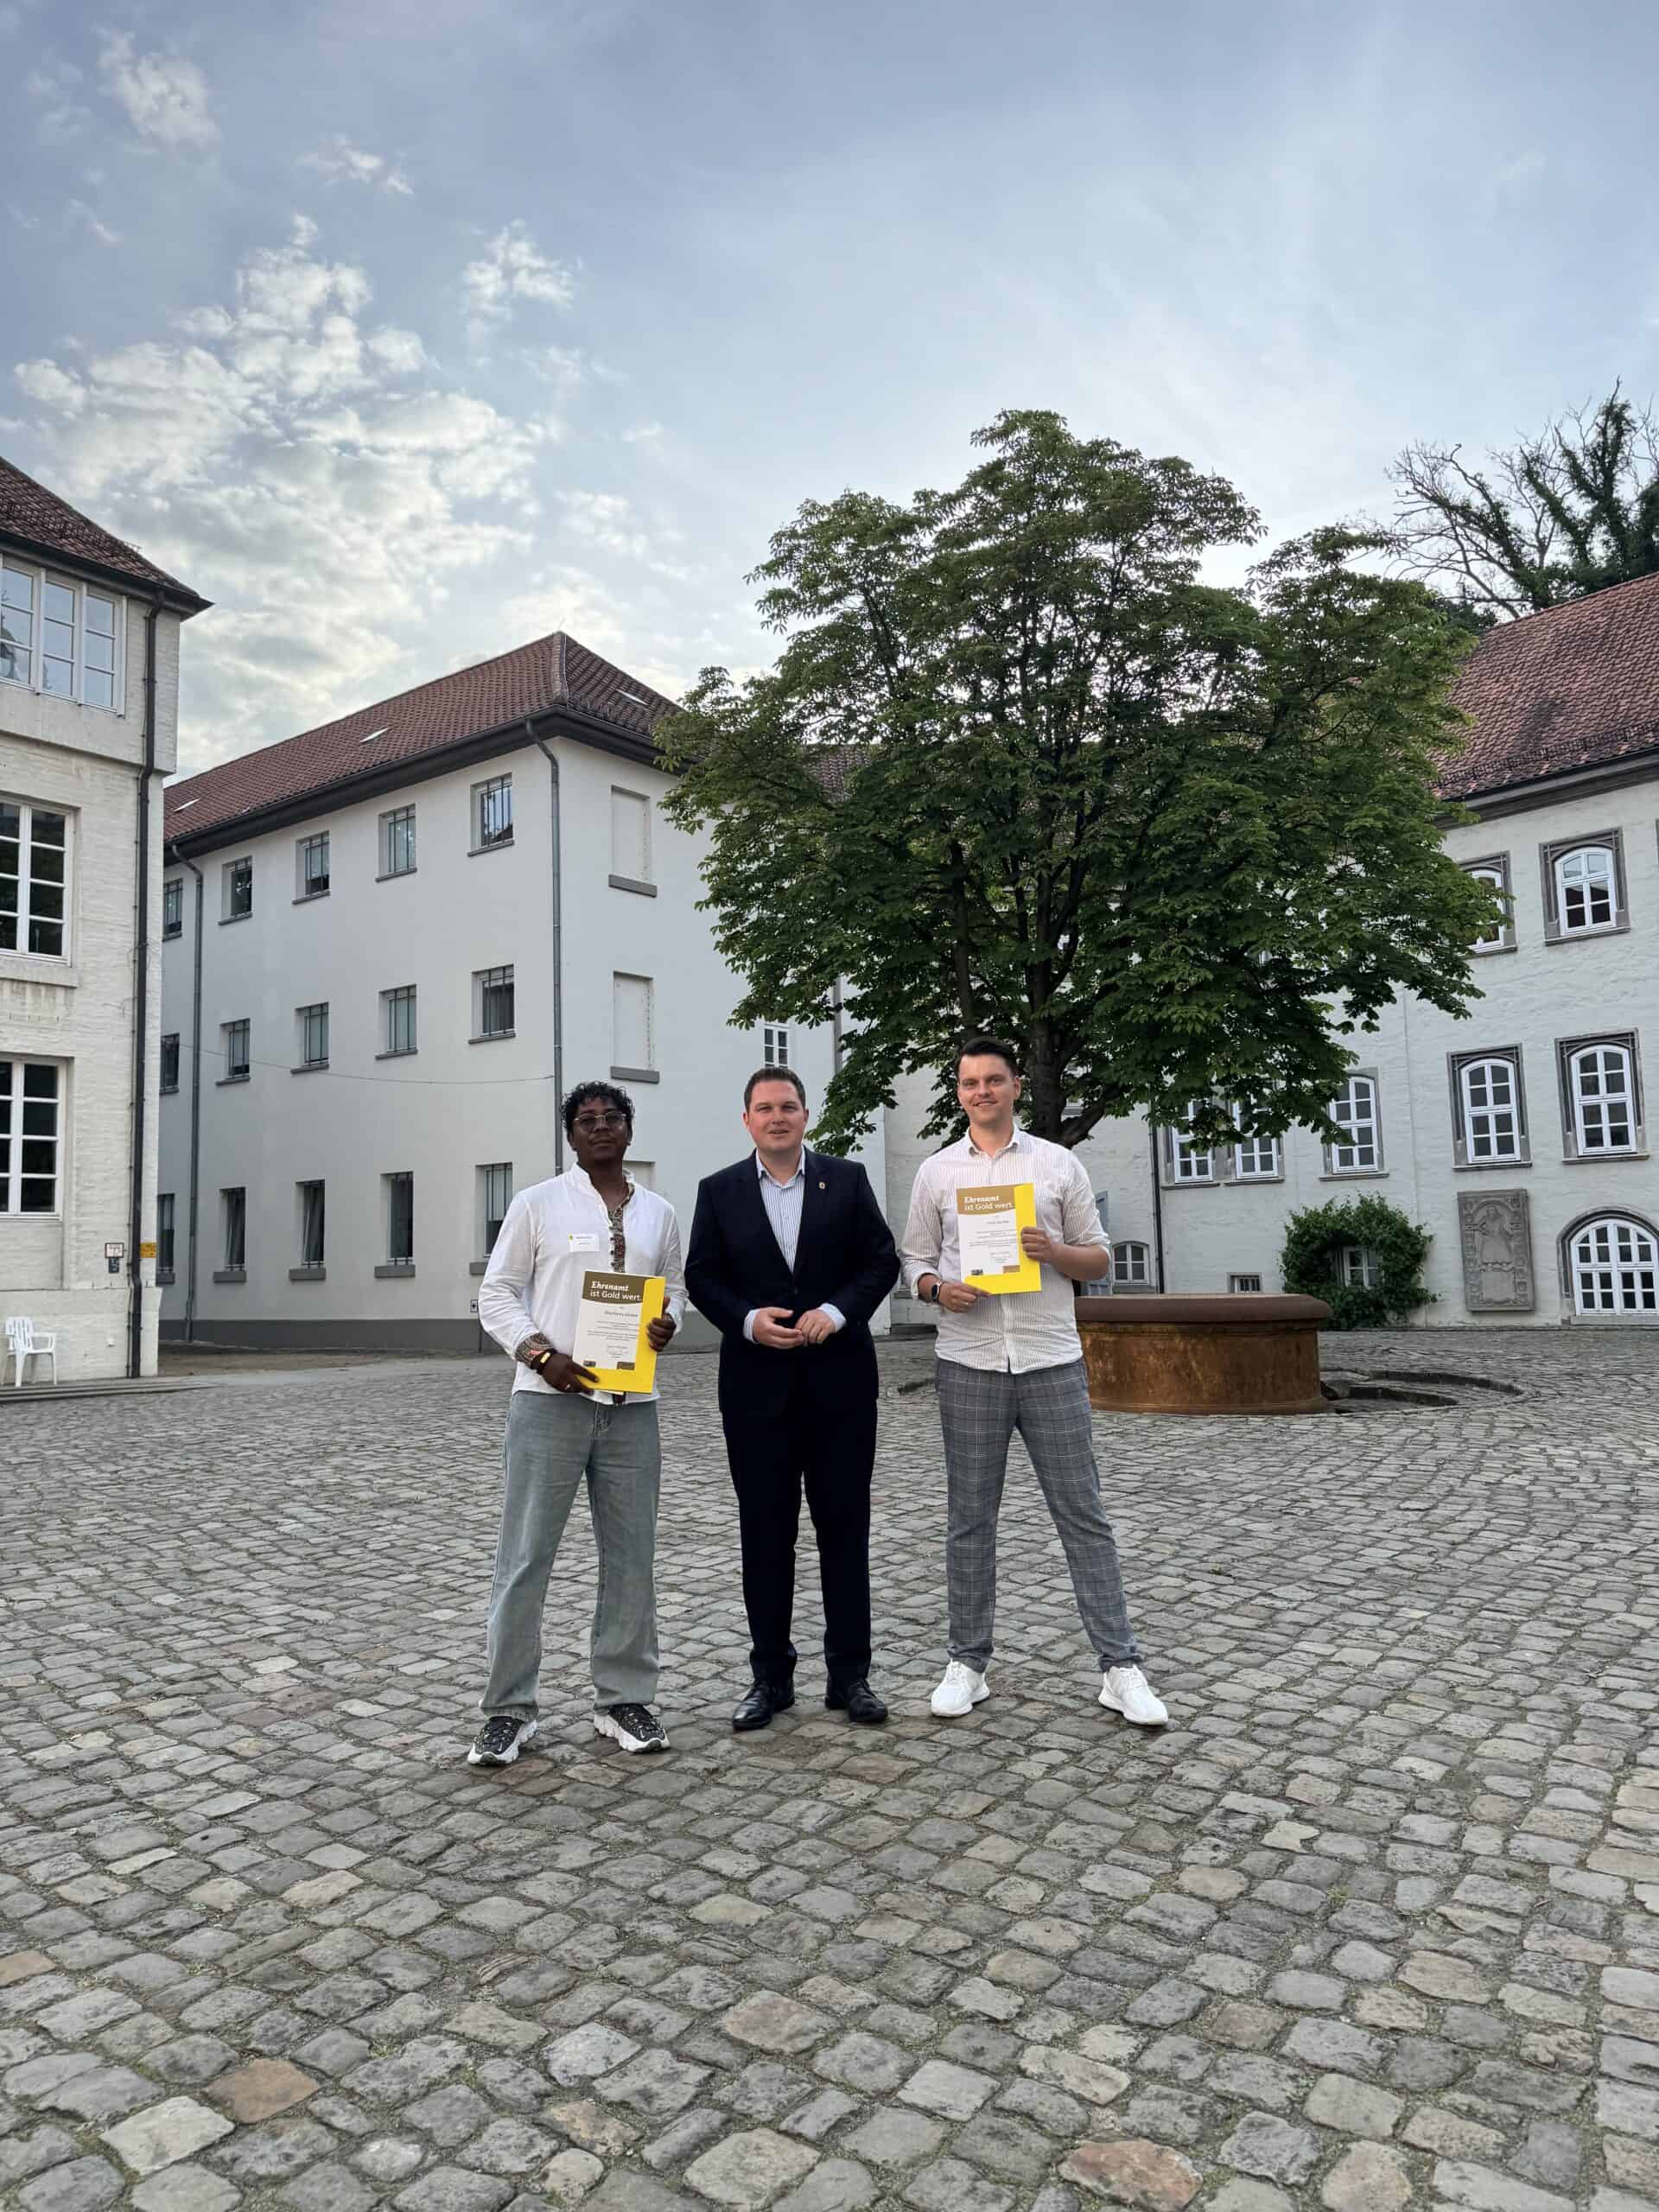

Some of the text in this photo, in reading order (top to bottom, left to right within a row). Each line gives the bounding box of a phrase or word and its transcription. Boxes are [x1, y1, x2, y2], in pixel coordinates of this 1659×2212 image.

[975, 1202, 993, 1211] Gold
[591, 1281, 629, 1291] Ehrenamt
[590, 1288, 600, 1297] ist
[601, 1290, 620, 1300] Gold
